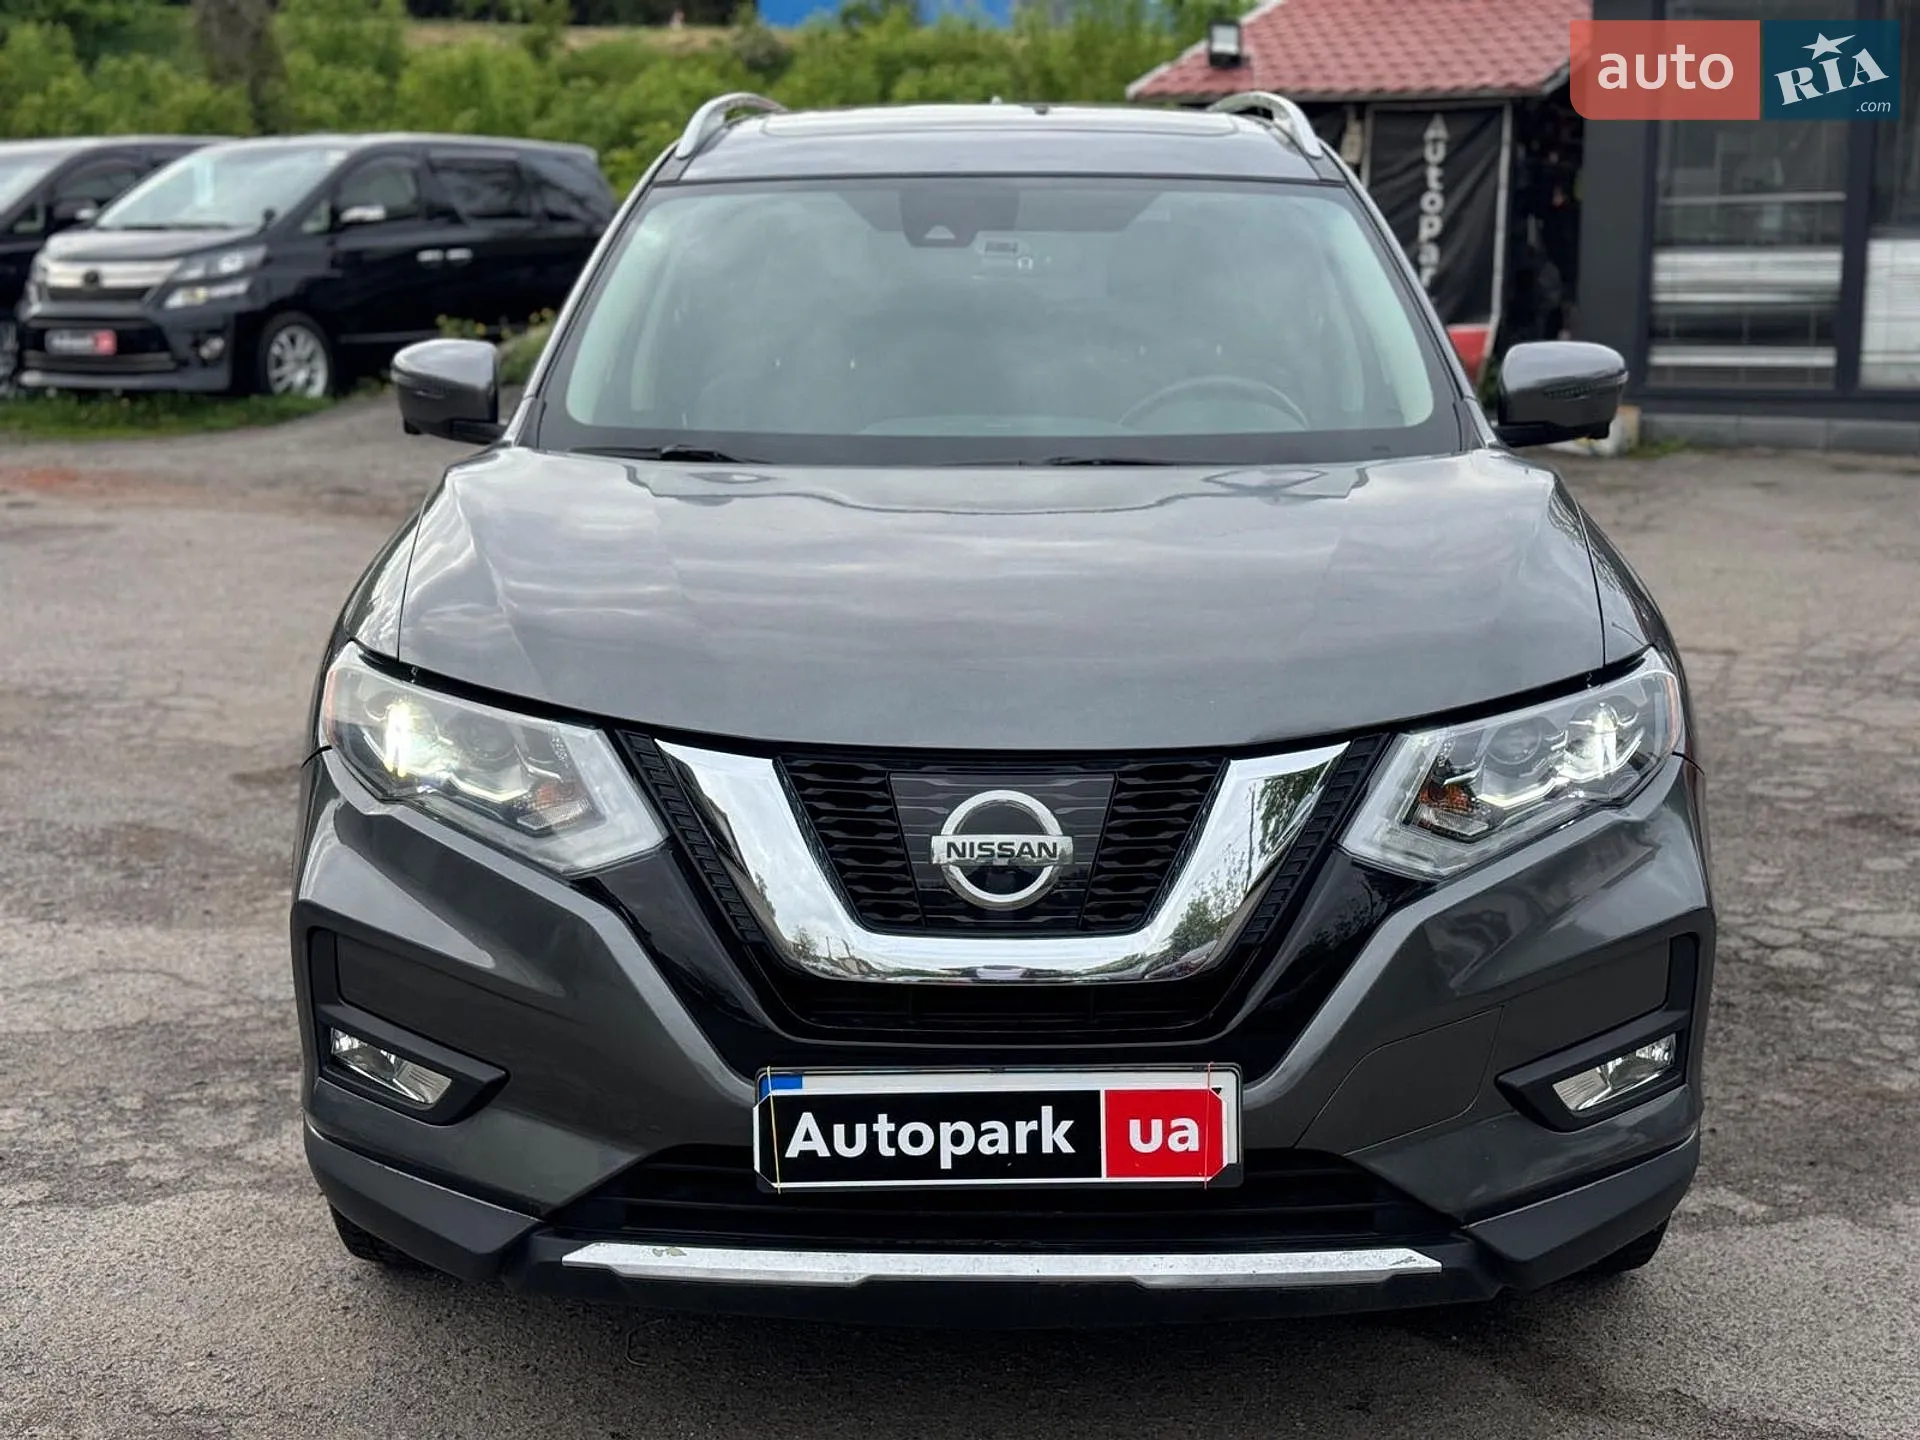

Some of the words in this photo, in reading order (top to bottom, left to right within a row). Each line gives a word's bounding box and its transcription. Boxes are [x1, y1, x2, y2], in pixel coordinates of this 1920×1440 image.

[1419, 113, 1448, 302] Autopar
[946, 841, 1058, 859] NISSAN
[784, 1105, 1075, 1169] Autopark
[1128, 1116, 1200, 1152] ua
